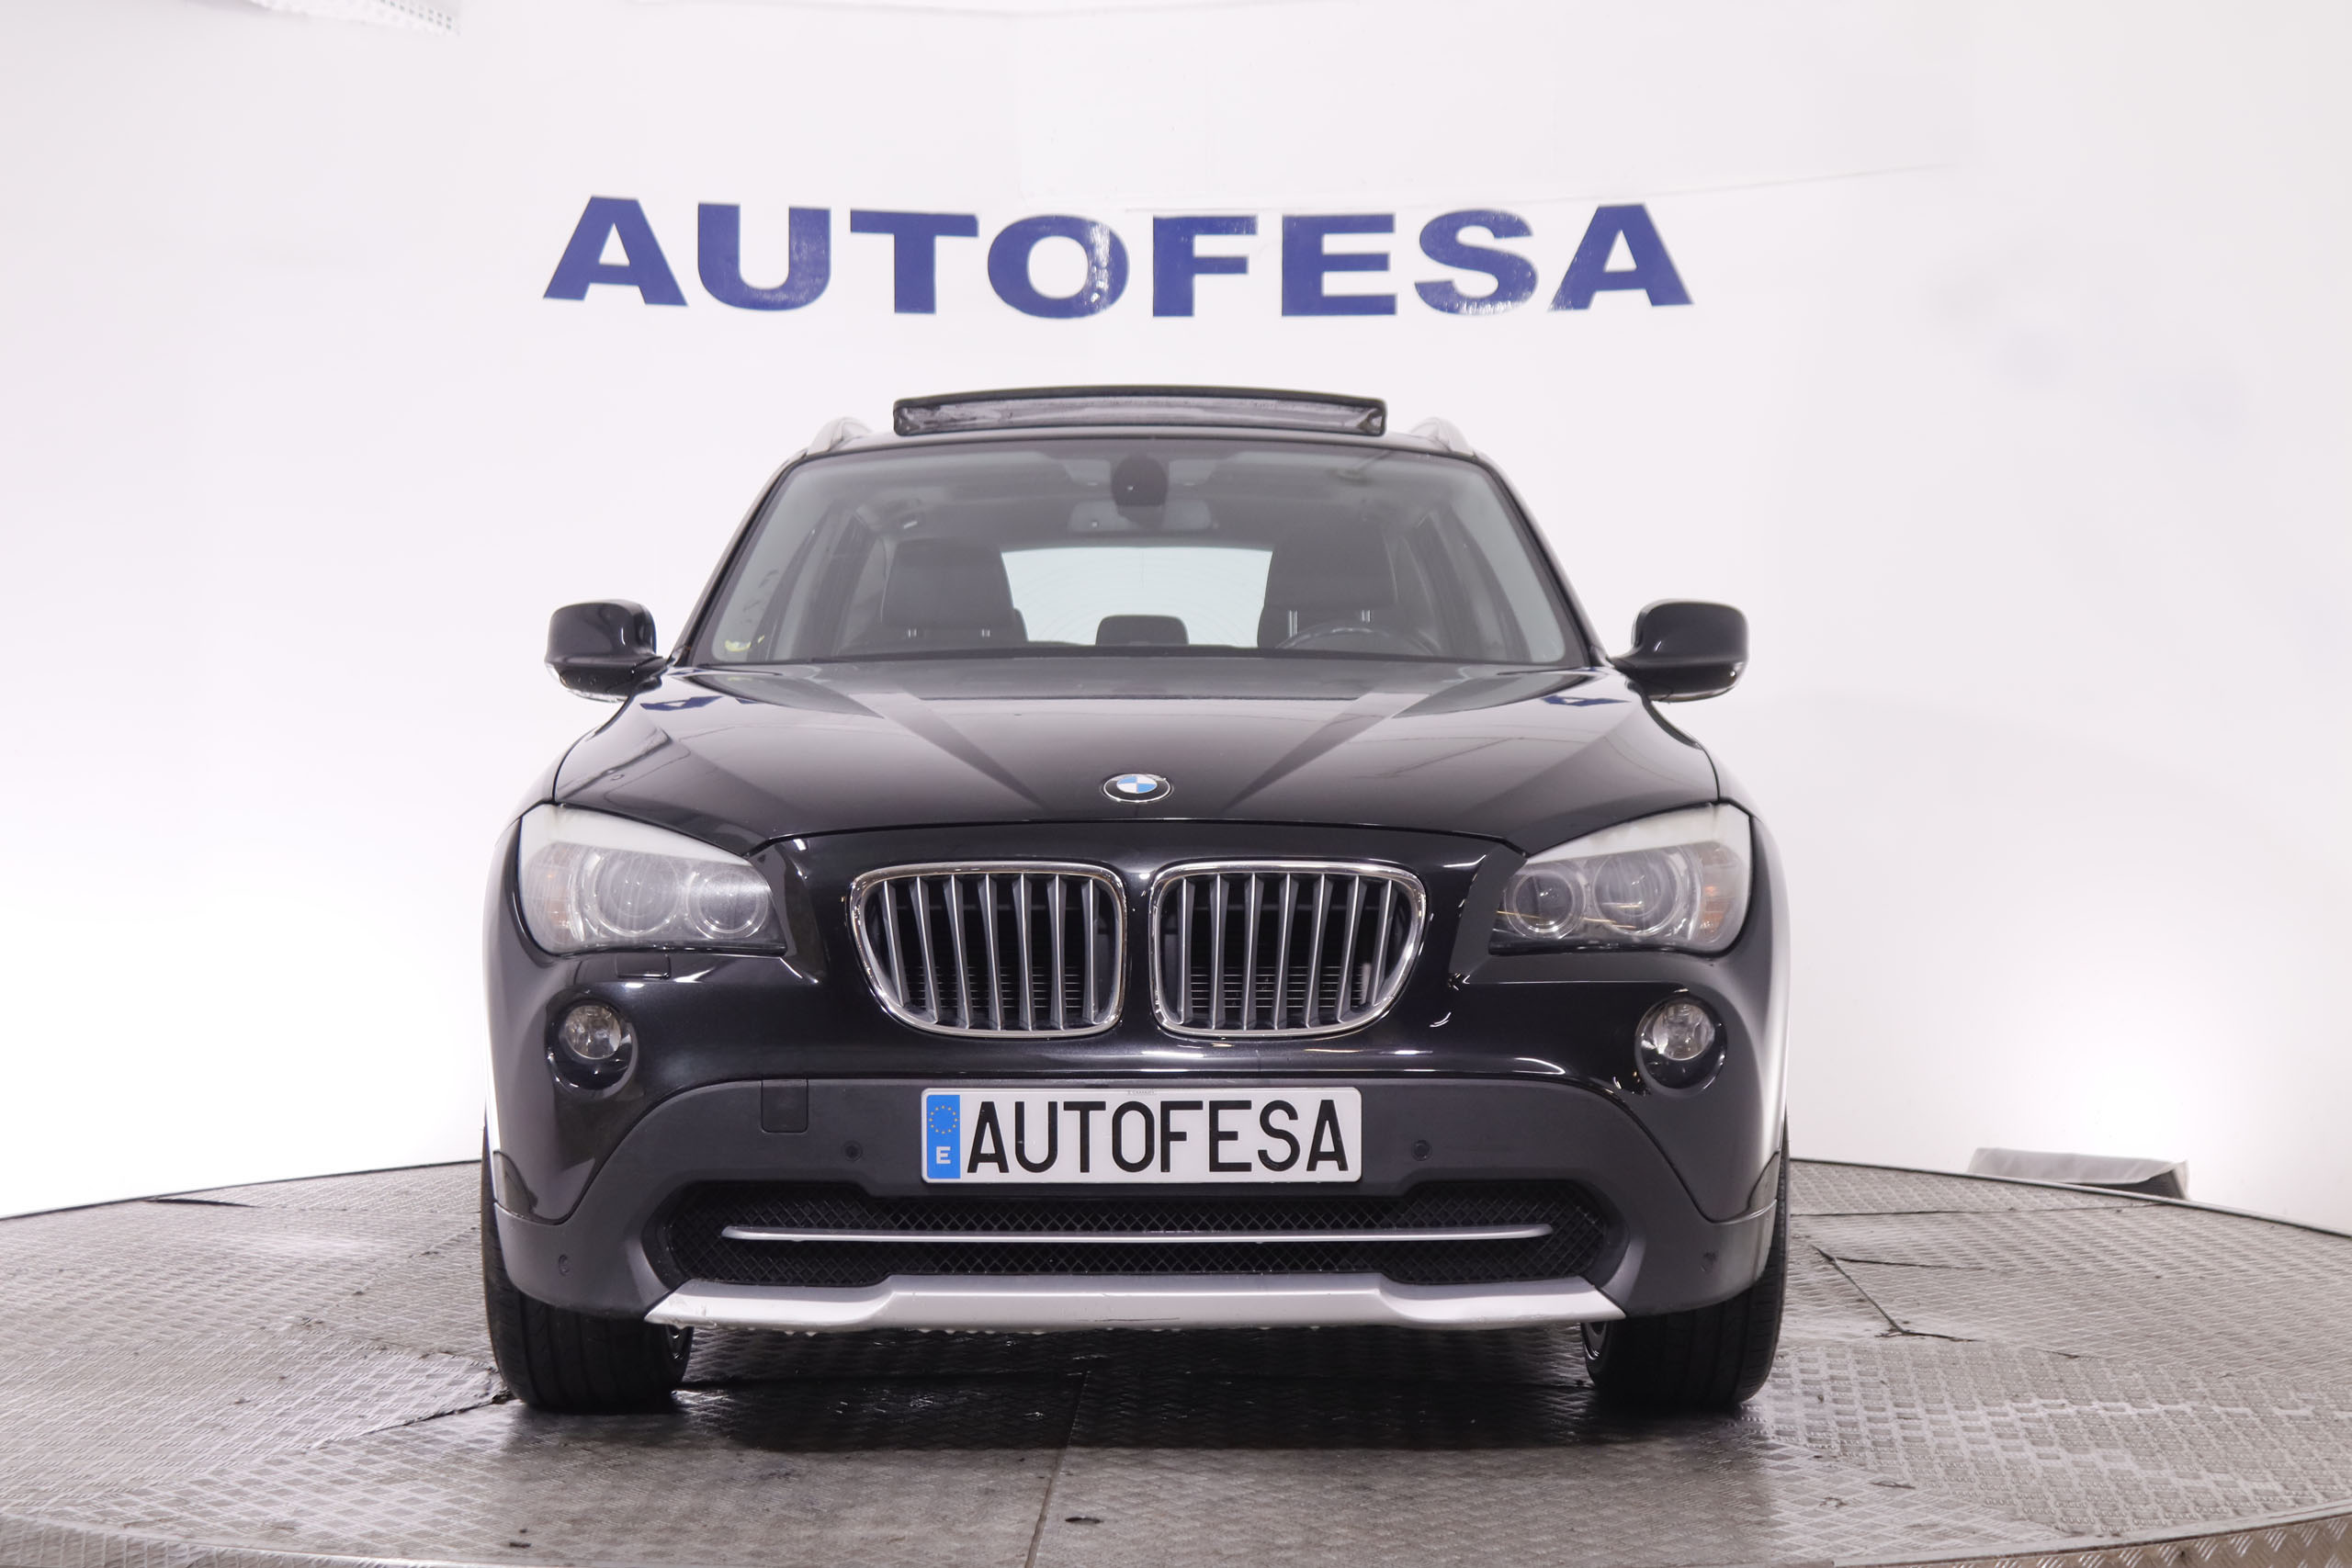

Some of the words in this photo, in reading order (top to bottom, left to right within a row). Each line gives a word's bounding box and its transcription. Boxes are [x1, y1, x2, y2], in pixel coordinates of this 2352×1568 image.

[543, 196, 1693, 319] AUTOFESA
[935, 1145, 952, 1165] E
[967, 1099, 1349, 1174] AUTOFESA
